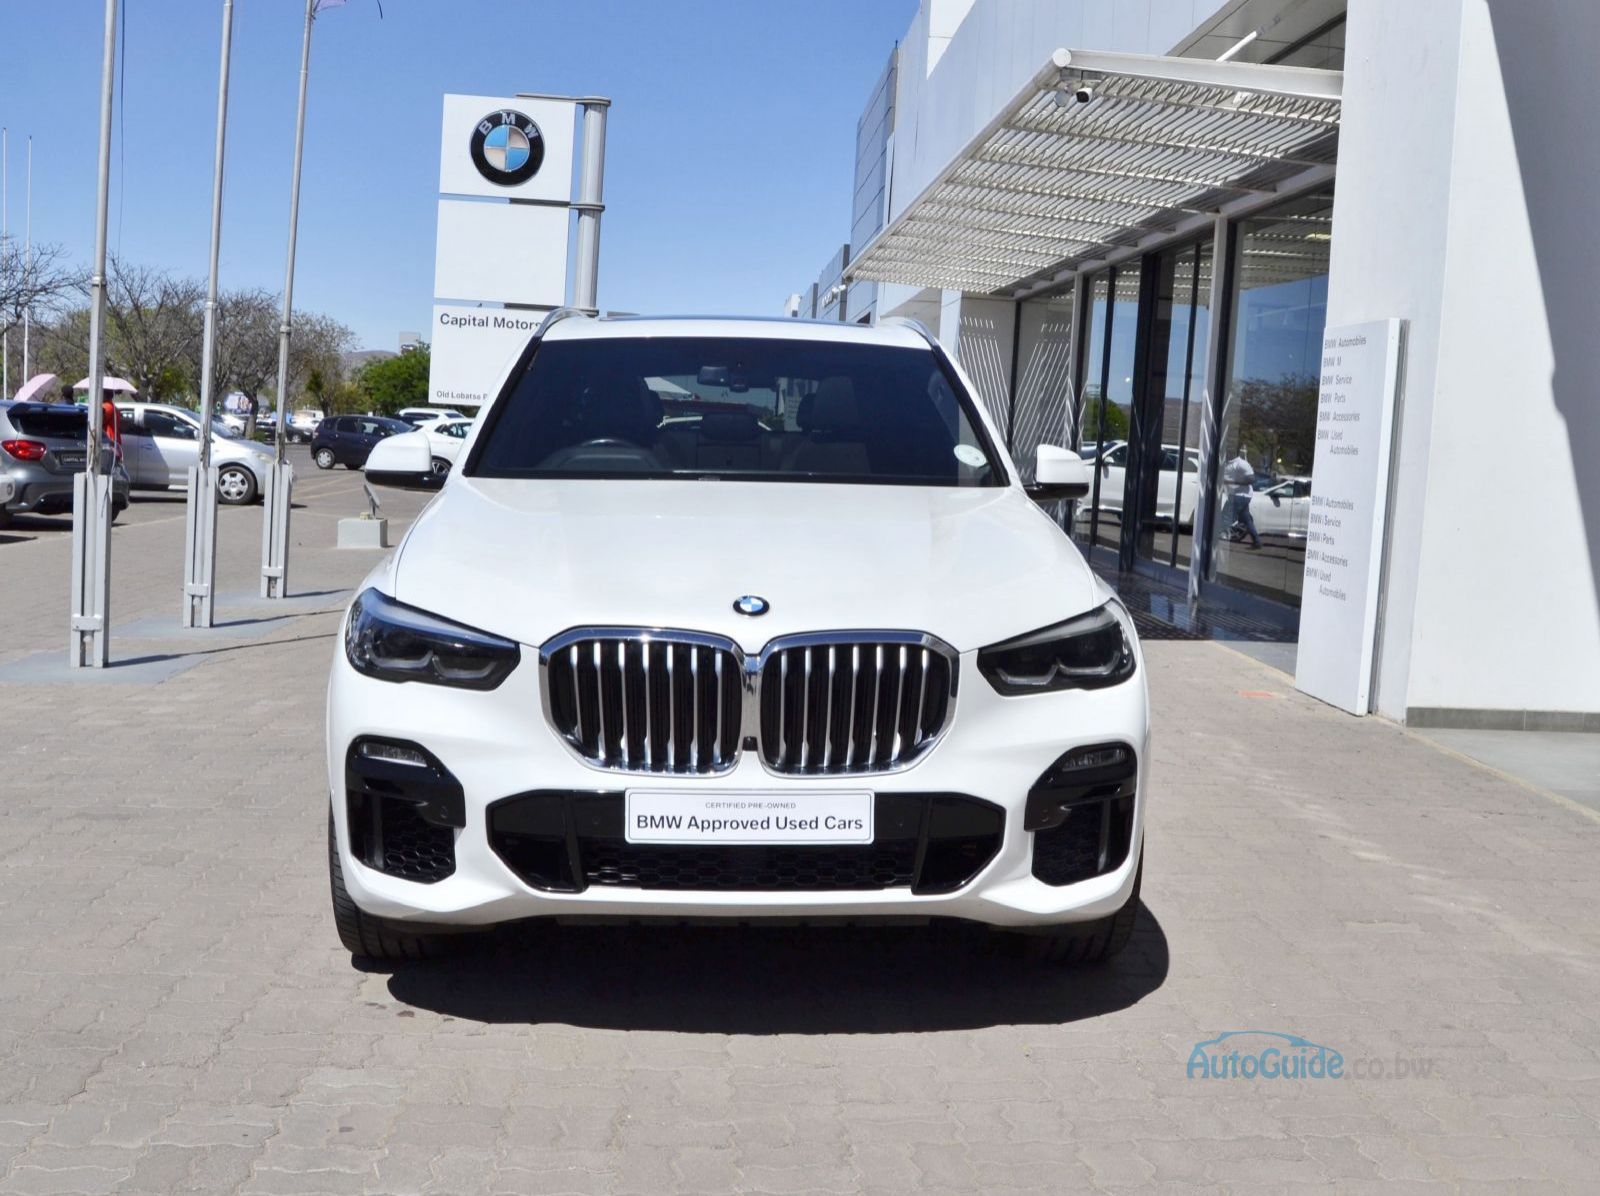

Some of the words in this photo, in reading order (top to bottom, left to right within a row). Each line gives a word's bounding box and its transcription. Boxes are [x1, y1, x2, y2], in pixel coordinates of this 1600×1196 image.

[479, 111, 539, 139] BMW
[440, 313, 489, 328] Capital
[1324, 339, 1337, 350] BMW
[1338, 335, 1367, 347] Automobiles
[1323, 357, 1335, 368] BMW
[1321, 375, 1334, 386] BMW
[1335, 374, 1353, 385] Service
[436, 390, 450, 399] Old
[451, 391, 481, 400] Lobatse
[1320, 393, 1332, 404] BMW
[1334, 392, 1346, 403] Parts
[1332, 410, 1361, 421] Accessories
[1331, 428, 1344, 441] Used
[1329, 445, 1359, 456] Automobiles
[1326, 497, 1354, 511] Automobiles
[1324, 514, 1341, 528] Service
[1321, 552, 1348, 568] Accessories
[1319, 585, 1347, 601] Automobiles
[705, 801, 747, 809] CERTIFIED
[747, 801, 796, 809] PRE-OWNED
[637, 814, 683, 829] BMW
[687, 815, 770, 833] Approved
[775, 815, 819, 830] Used
[824, 815, 863, 830] Cars
